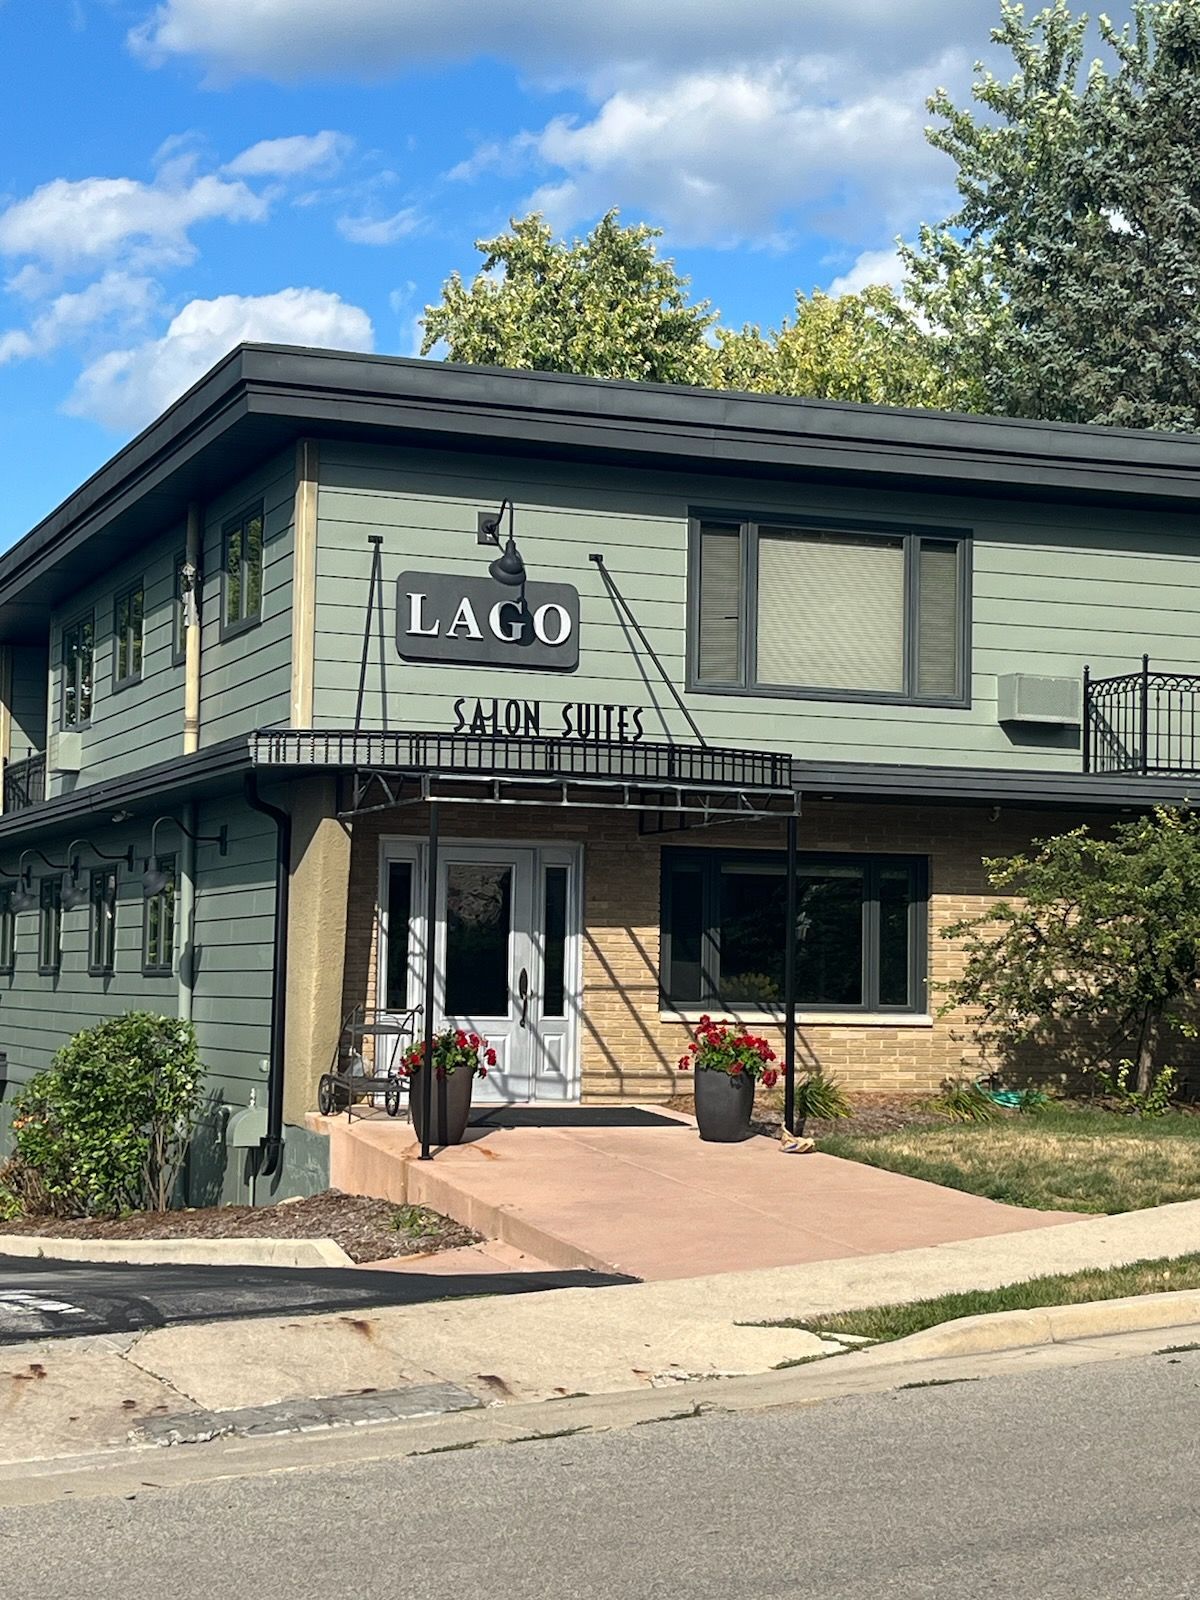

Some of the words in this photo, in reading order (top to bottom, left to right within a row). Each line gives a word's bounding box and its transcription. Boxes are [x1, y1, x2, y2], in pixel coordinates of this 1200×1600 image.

[405, 593, 571, 645] LAGO
[453, 698, 540, 737] SALON
[562, 703, 643, 742] SUITES
